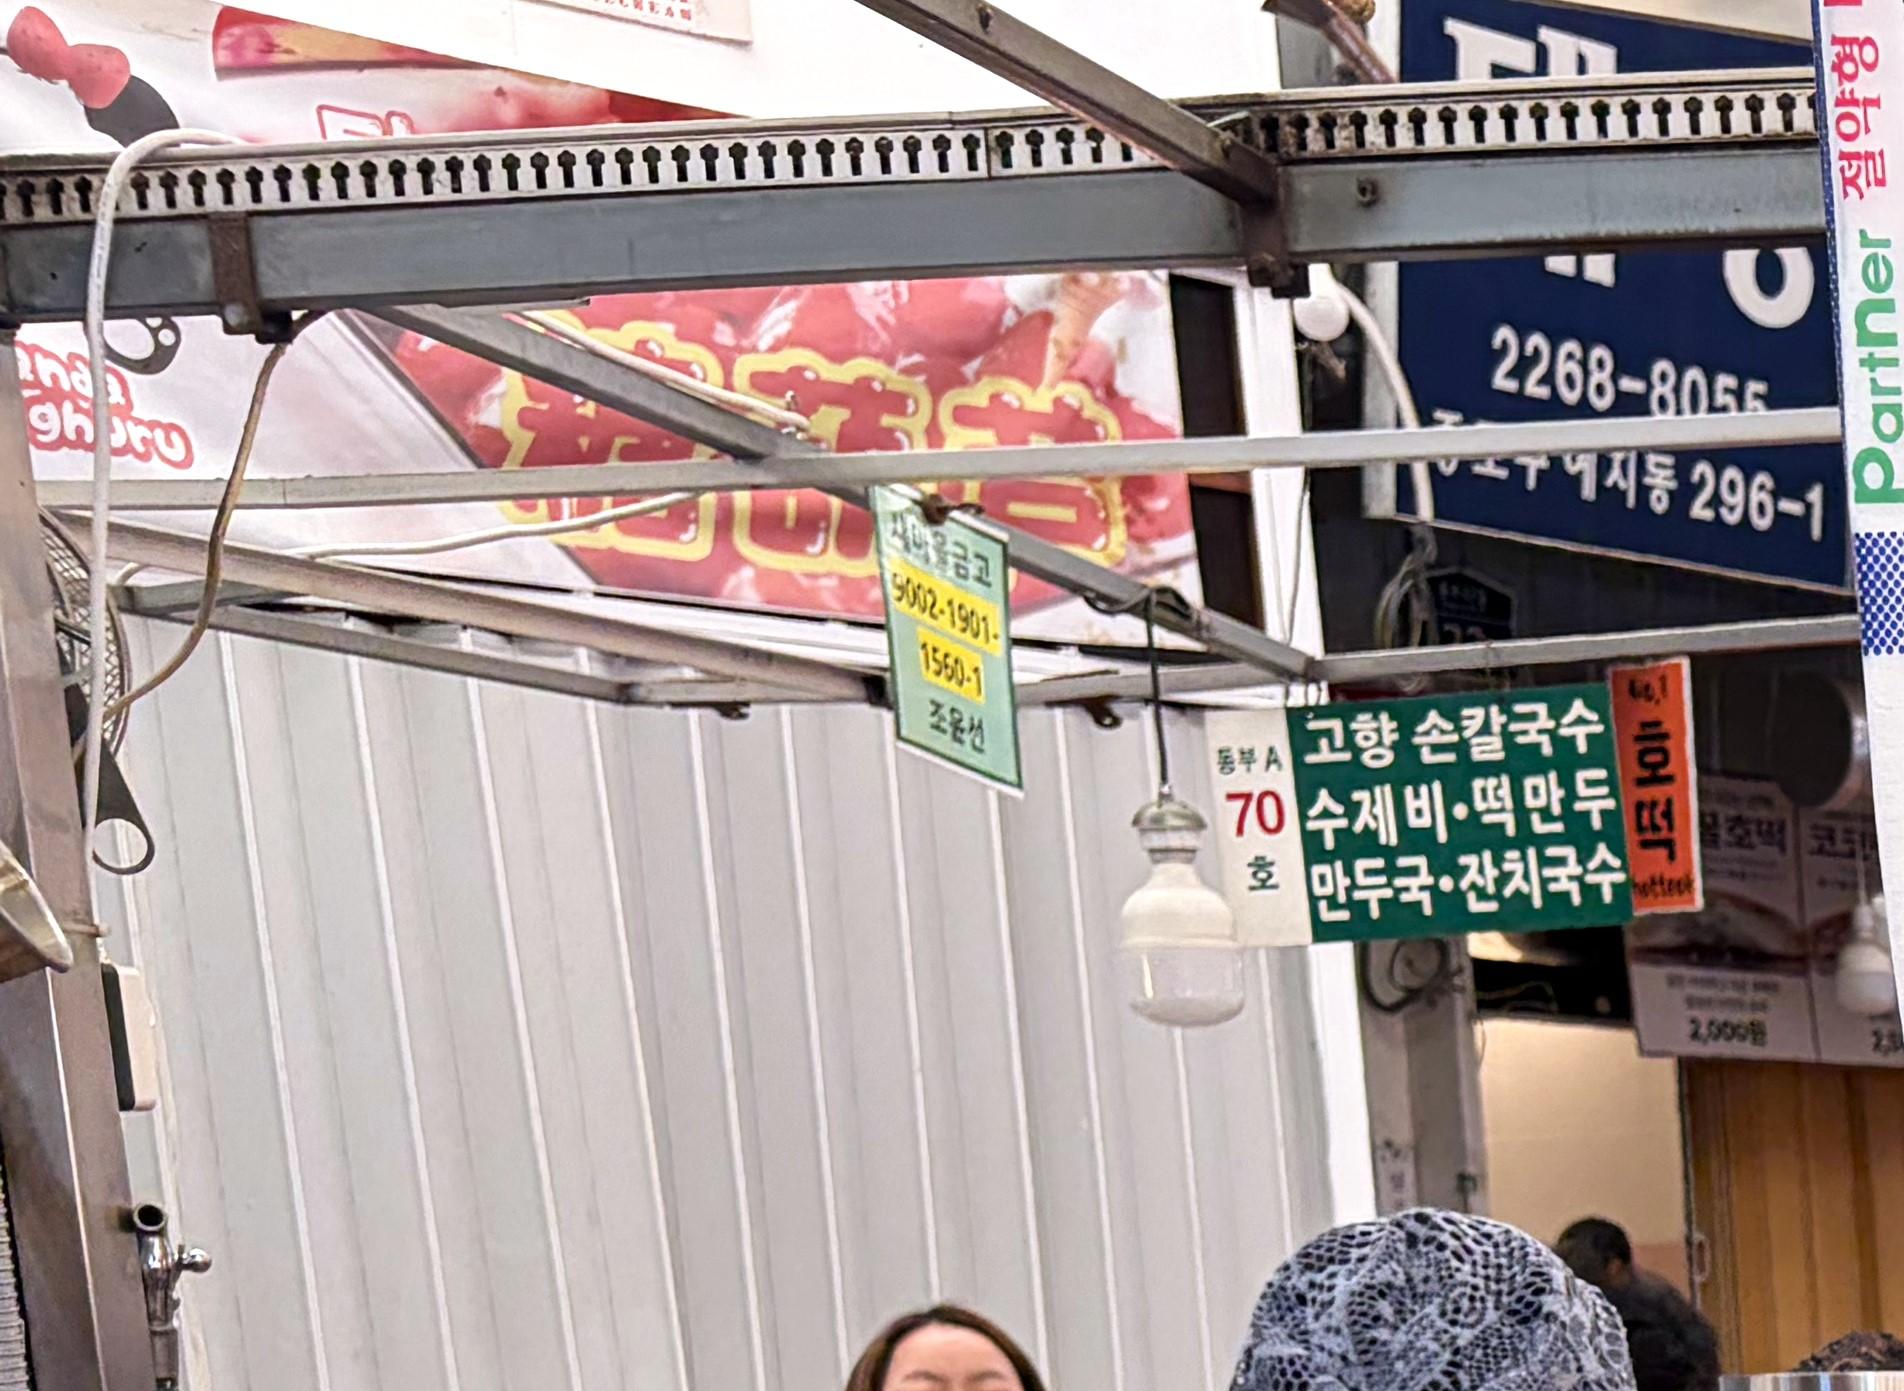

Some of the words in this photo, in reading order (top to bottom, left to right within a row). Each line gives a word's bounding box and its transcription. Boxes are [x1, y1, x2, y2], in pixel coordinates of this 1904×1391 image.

[1830, 34, 1887, 200] 절약형
[1689, 460, 1824, 543] 296-1
[1303, 711, 1399, 768] 고향
[1411, 698, 1606, 766] 손칼국수
[1225, 789, 1286, 838] 70
[1247, 855, 1280, 893] 호
